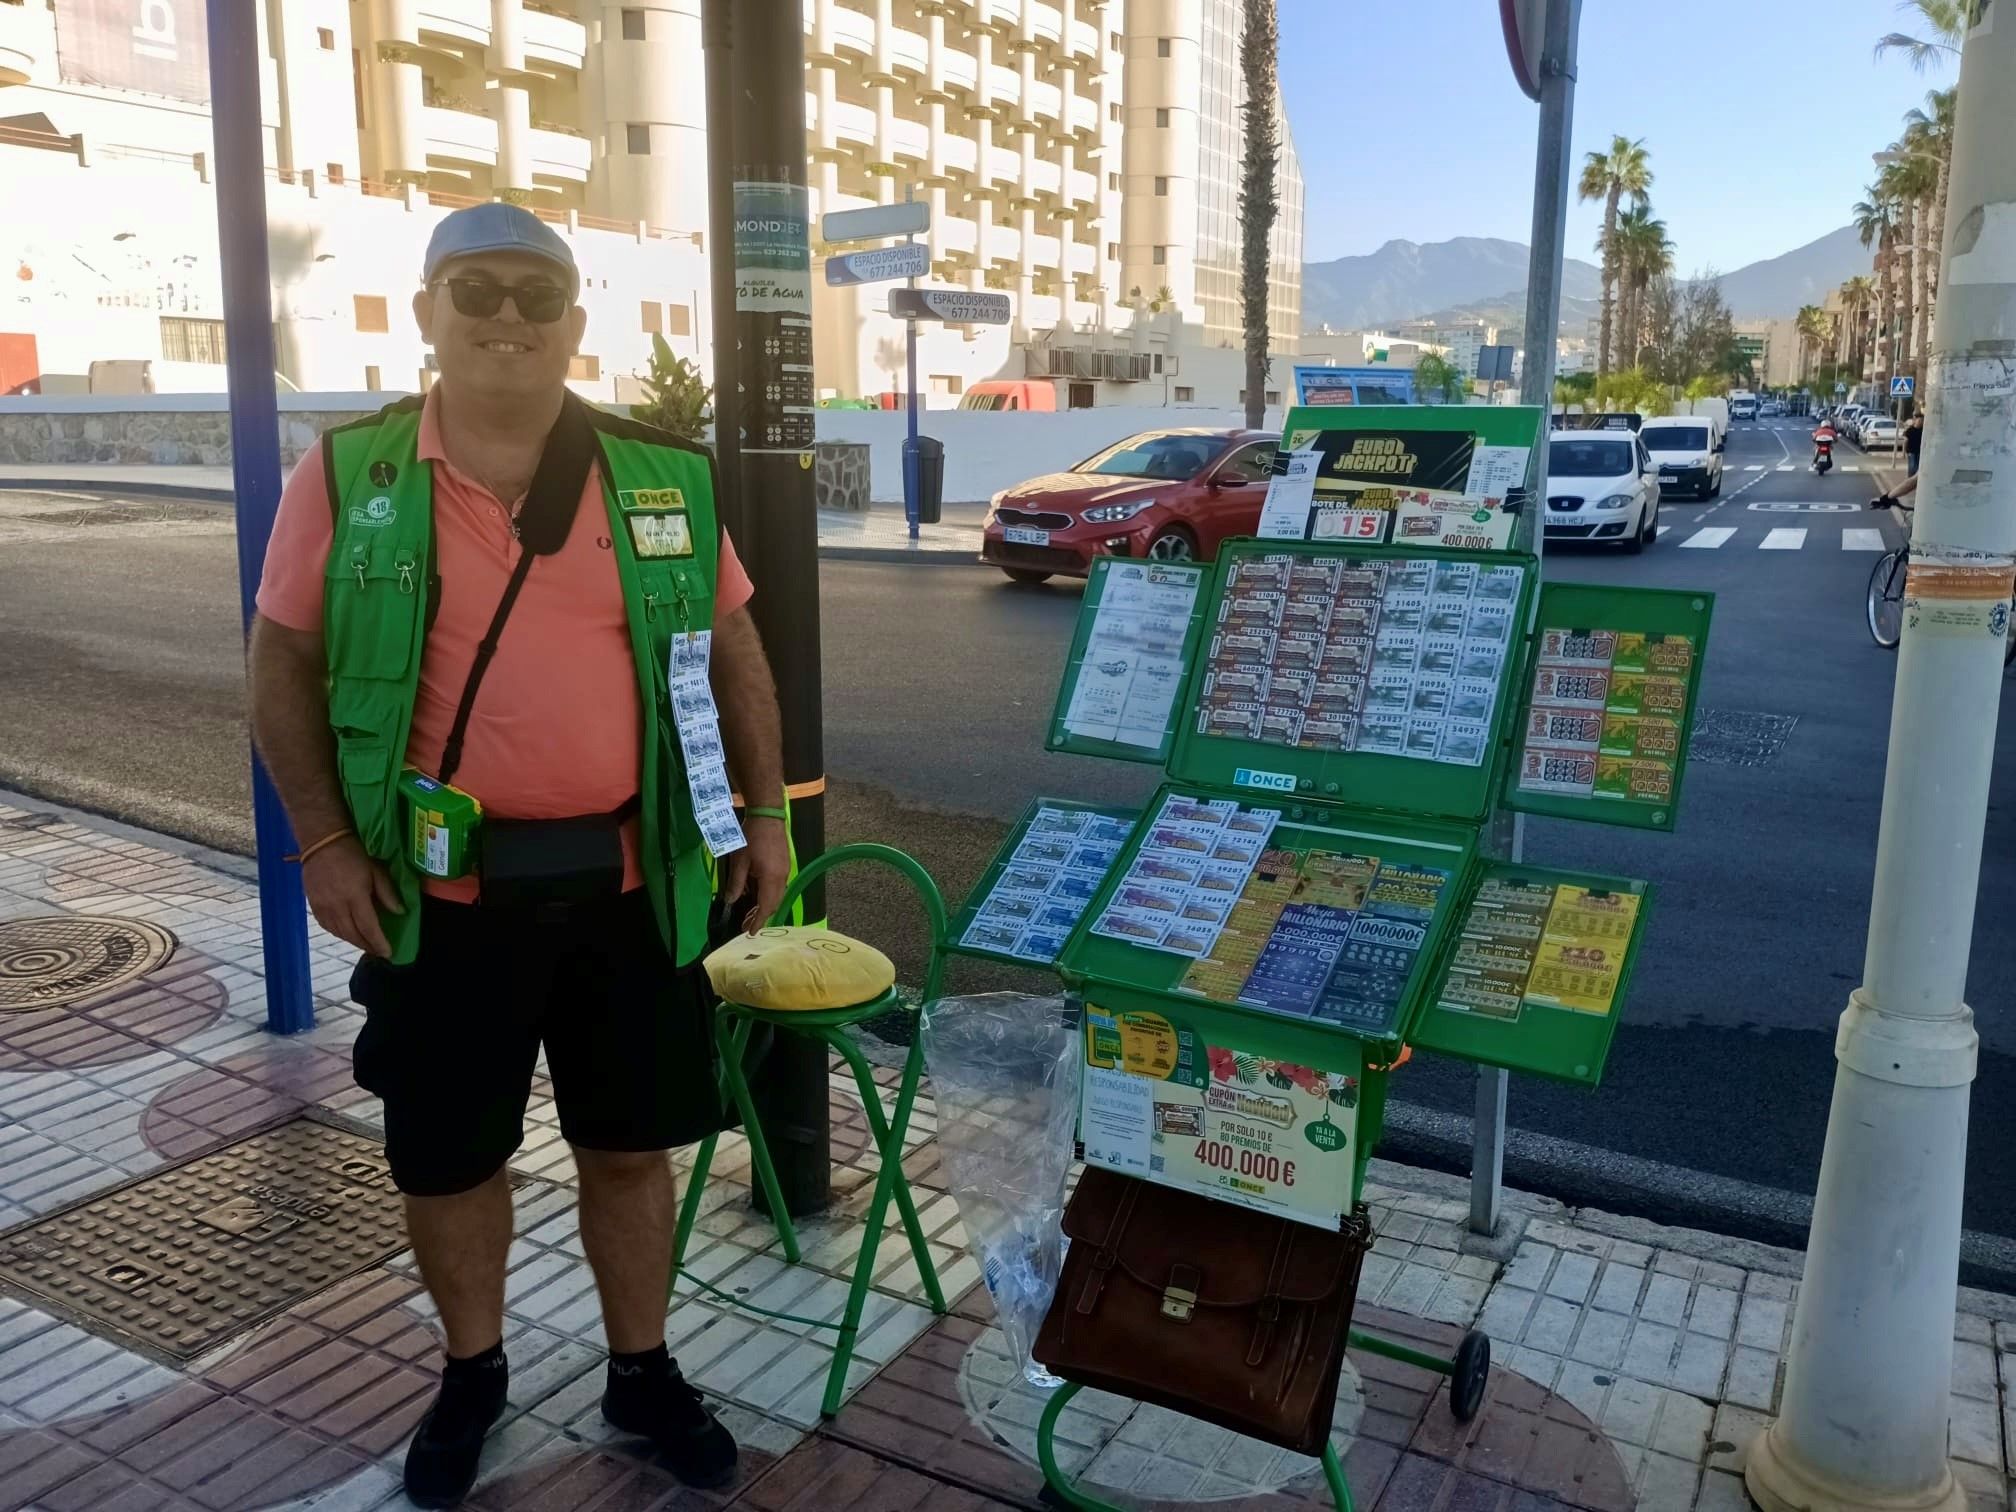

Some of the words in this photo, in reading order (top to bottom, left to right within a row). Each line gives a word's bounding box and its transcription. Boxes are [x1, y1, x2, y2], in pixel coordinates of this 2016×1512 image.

[854, 254, 882, 268] ESPACIO
[882, 247, 921, 264] DISPONIBLE
[870, 266, 886, 279] 677
[887, 264, 904, 277] 244
[905, 261, 922, 274] 706
[752, 287, 768, 299] DE
[772, 288, 804, 300] AGUA
[933, 293, 965, 306] ESPACIO
[965, 294, 1010, 308] DISPONIBLE
[951, 307, 969, 320] 677
[971, 308, 989, 321] 244
[991, 308, 1010, 322] 706
[1352, 438, 1402, 456] EURO
[1333, 454, 1415, 474] JACKPOT
[638, 492, 680, 505] ONCE
[1362, 488, 1394, 499] EURO
[1312, 501, 1334, 509] BOTE
[1252, 775, 1293, 788] ONCE
[1281, 912, 1349, 931] MILLONARIO
[1276, 926, 1344, 943] 1.000.000€
[1355, 920, 1425, 943] 1000000€
[1209, 1086, 1236, 1102] CUPÓN
[1208, 1099, 1227, 1109] EXTRA
[1220, 1121, 1236, 1134] POR
[1236, 1124, 1255, 1138] SOLO
[1257, 1129, 1266, 1140] 10
[1315, 1126, 1324, 1134] YA
[1328, 1129, 1336, 1138] LA
[1220, 1132, 1230, 1143] 80
[1230, 1134, 1262, 1152] PREMIOS
[1263, 1143, 1272, 1153] DE
[1315, 1134, 1336, 1147] VENTA
[1240, 1180, 1265, 1193] ONCE
[248, 1185, 332, 1217] endesa
